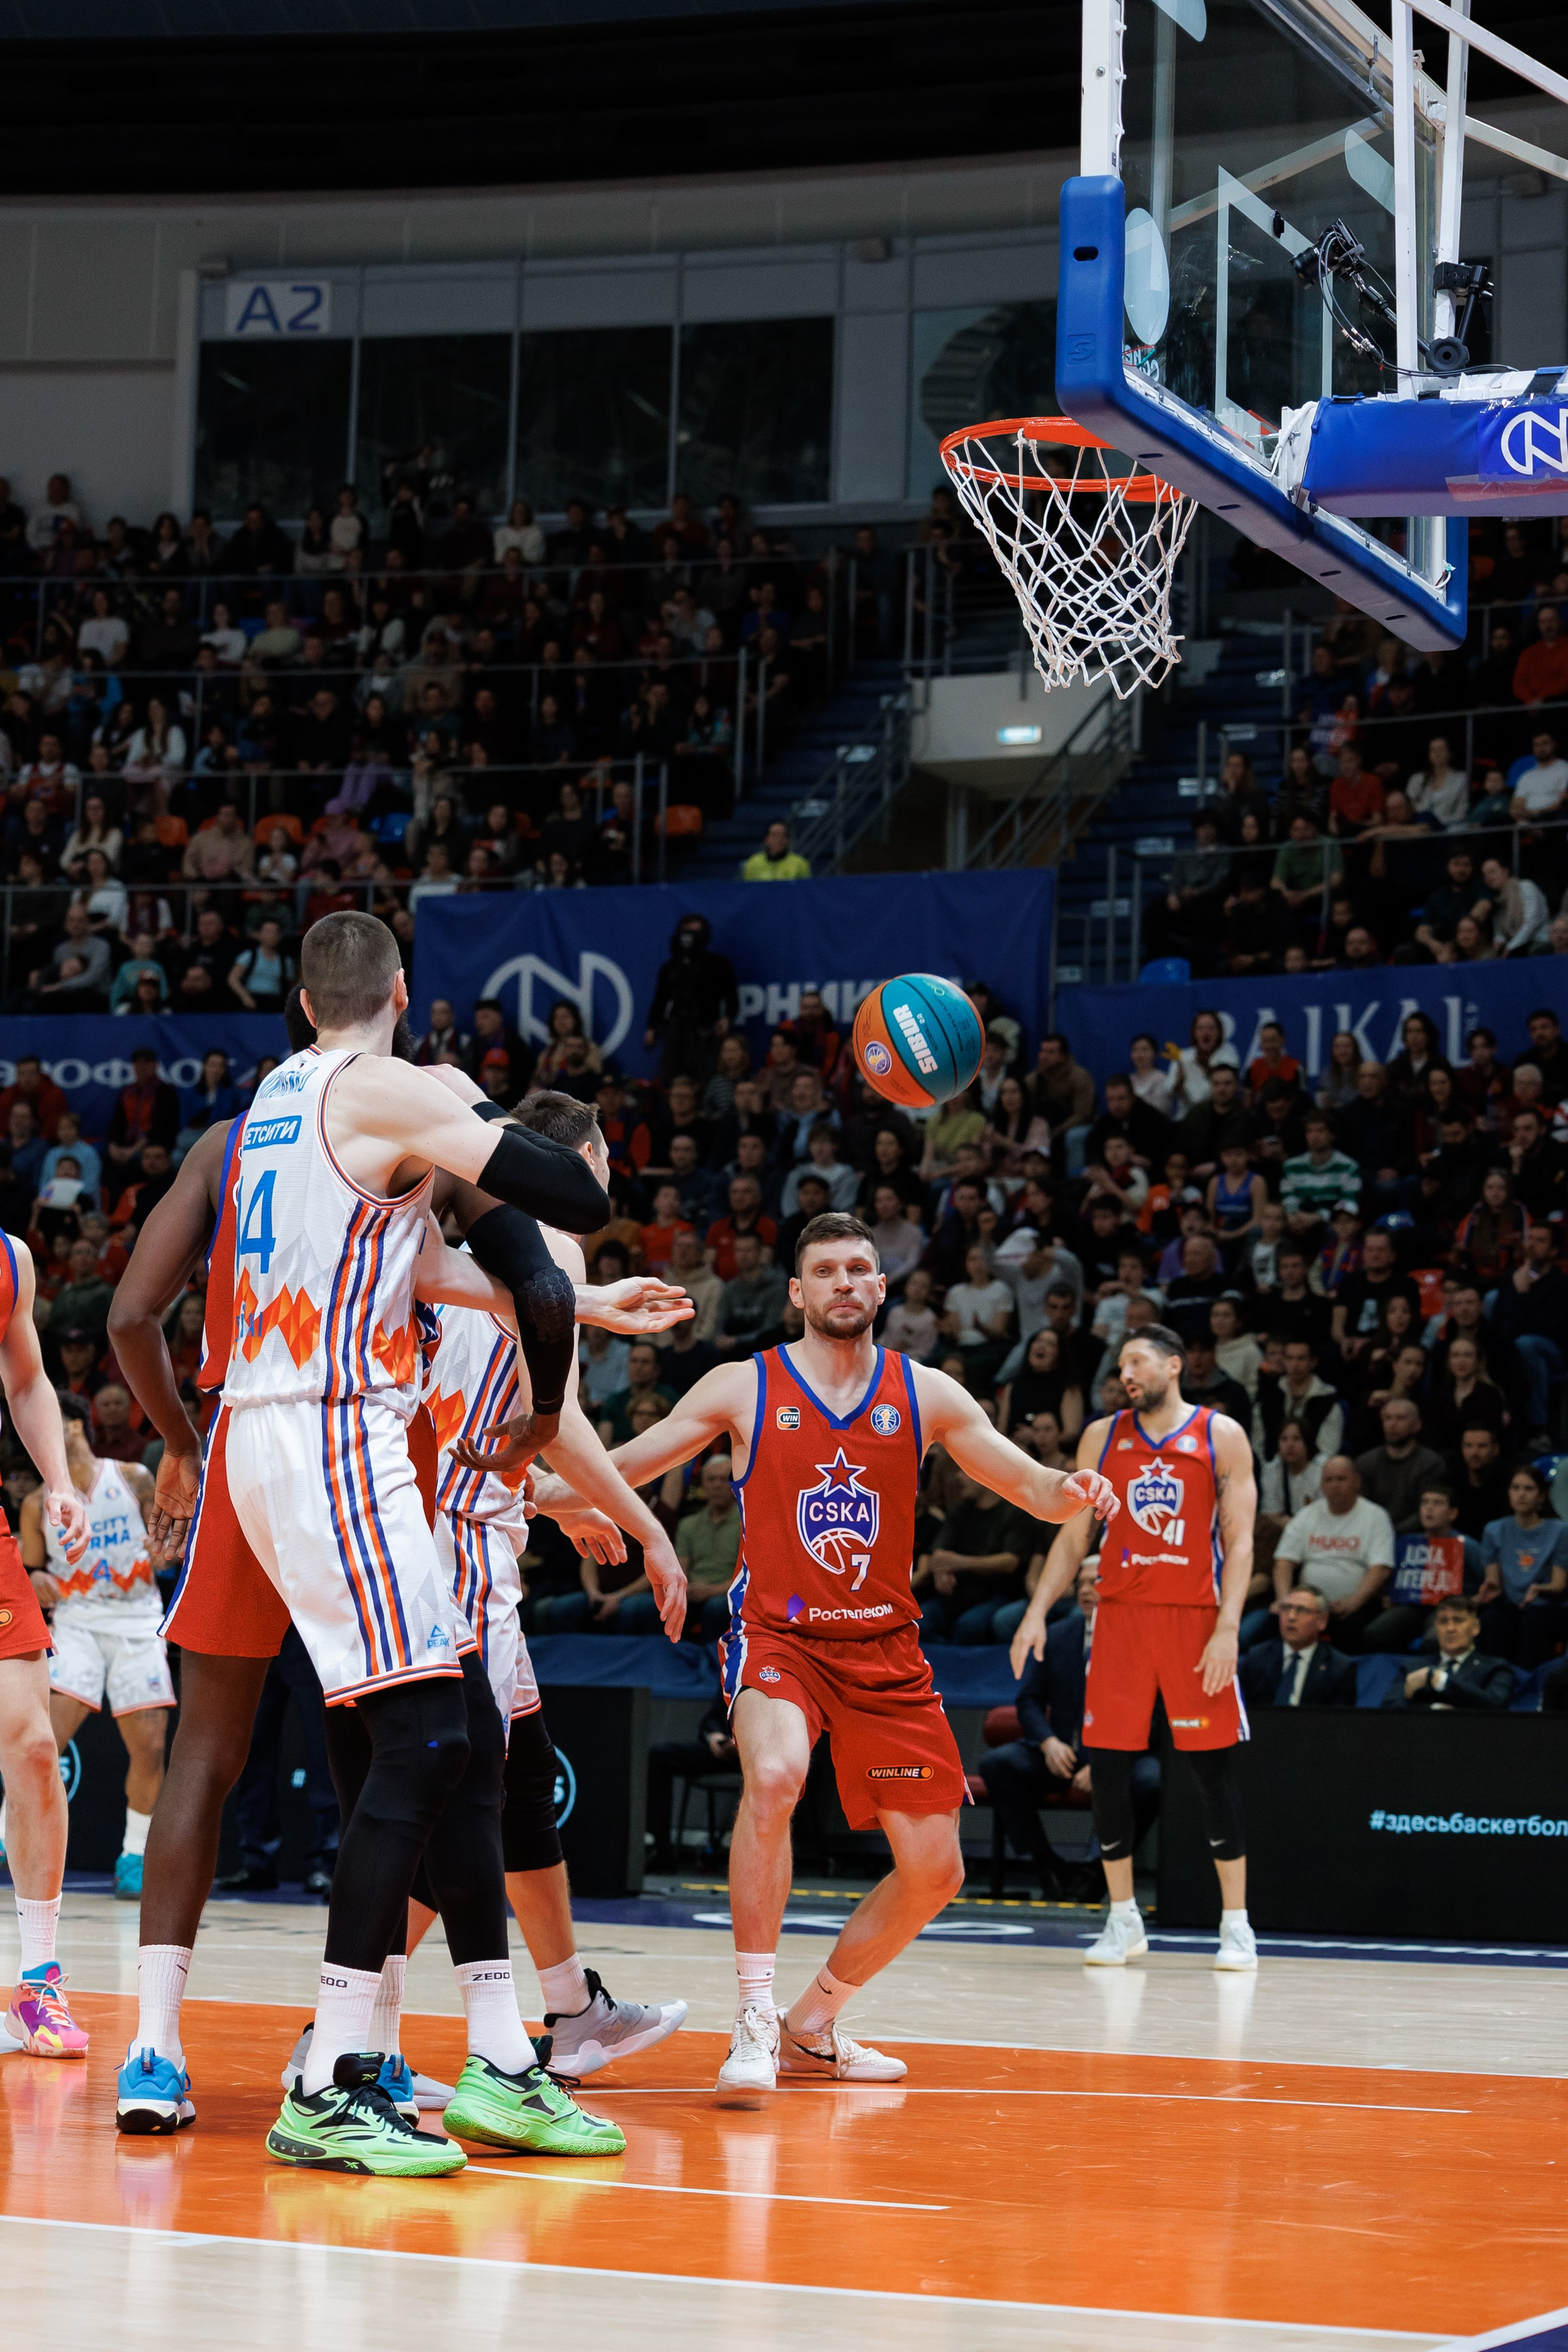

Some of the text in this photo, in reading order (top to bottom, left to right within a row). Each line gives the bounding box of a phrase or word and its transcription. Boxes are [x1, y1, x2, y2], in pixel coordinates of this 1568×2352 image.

[236, 286, 322, 332] A2
[892, 1004, 938, 1075] SIBUR
[1135, 1487, 1176, 1501] CSKA
[809, 1501, 870, 1522] CSKA
[63, 1529, 131, 1553] PRMA
[1162, 1518, 1186, 1546] 41
[92, 1558, 113, 1583] 4
[850, 1553, 872, 1592] 7
[809, 1603, 893, 1622] Ростелеком
[427, 1637, 449, 1649] PEAK
[872, 1768, 920, 1777] WINLINE
[320, 1975, 348, 1988] EDO
[472, 1972, 510, 1982] ZEDO
